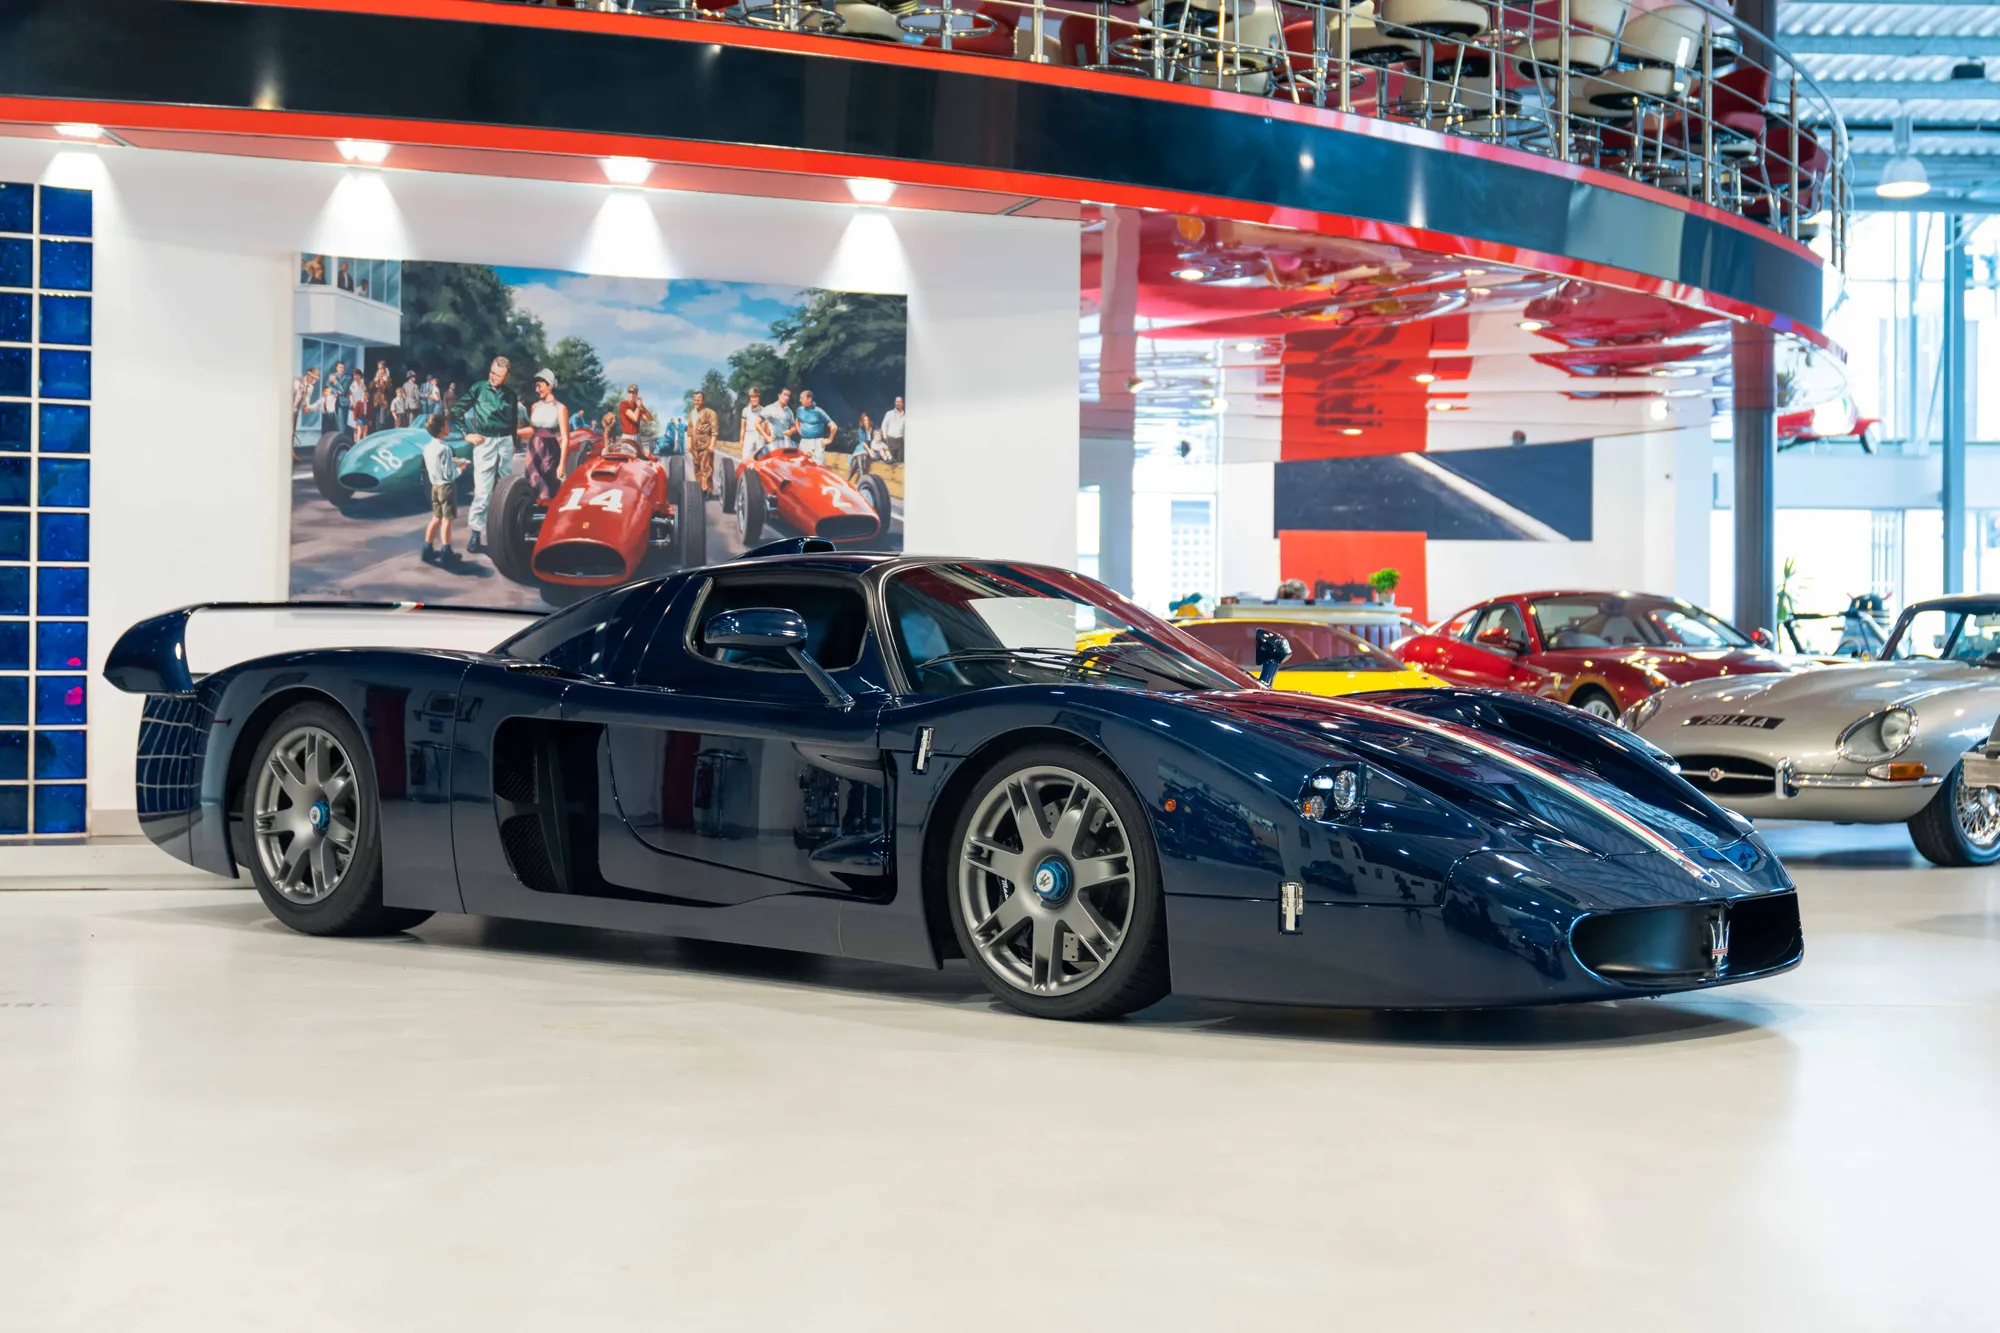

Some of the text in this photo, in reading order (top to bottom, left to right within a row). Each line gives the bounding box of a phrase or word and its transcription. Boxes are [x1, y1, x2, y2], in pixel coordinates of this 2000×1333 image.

[370, 449, 403, 471] 18
[558, 487, 623, 513] 14
[821, 485, 852, 508] 2
